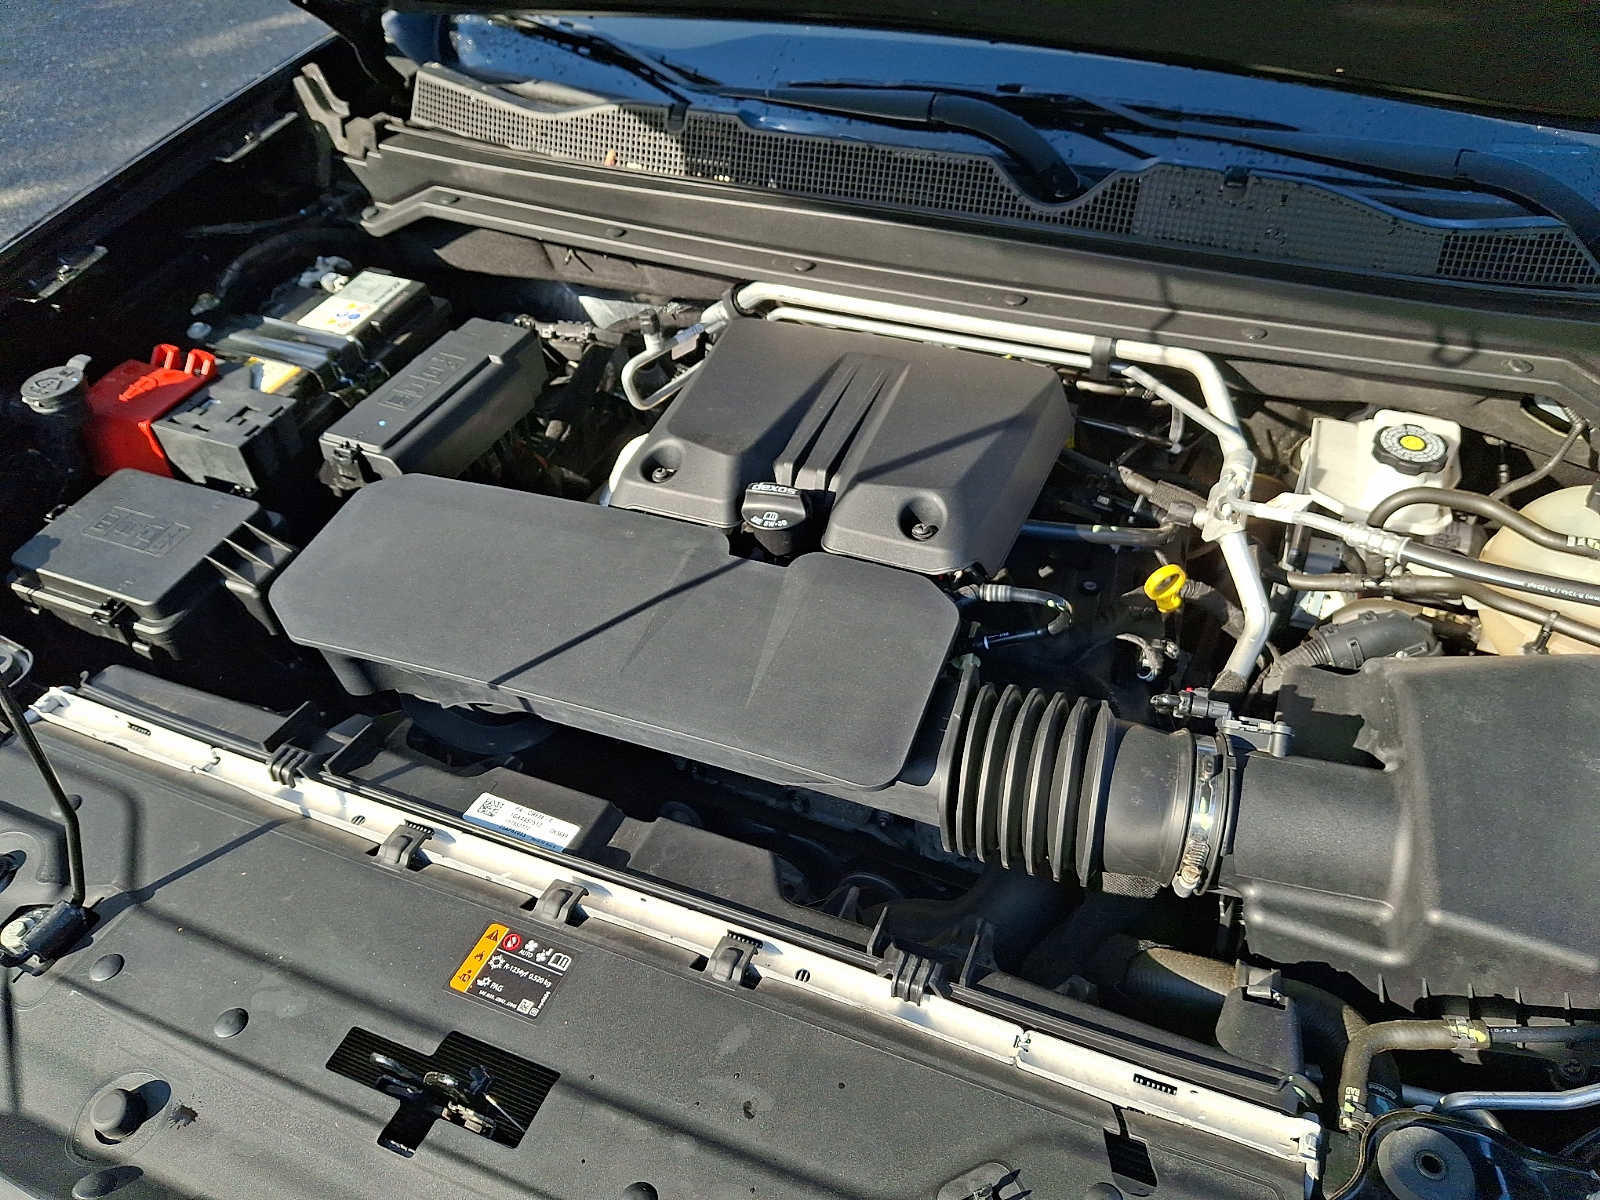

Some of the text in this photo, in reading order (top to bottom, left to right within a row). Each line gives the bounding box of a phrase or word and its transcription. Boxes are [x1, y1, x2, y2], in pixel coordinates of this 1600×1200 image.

[751, 482, 798, 495] dexos
[519, 949, 534, 958] AUTO
[503, 962, 552, 988] R-1234yf 0.520 kg
[489, 981, 504, 992] PAG
